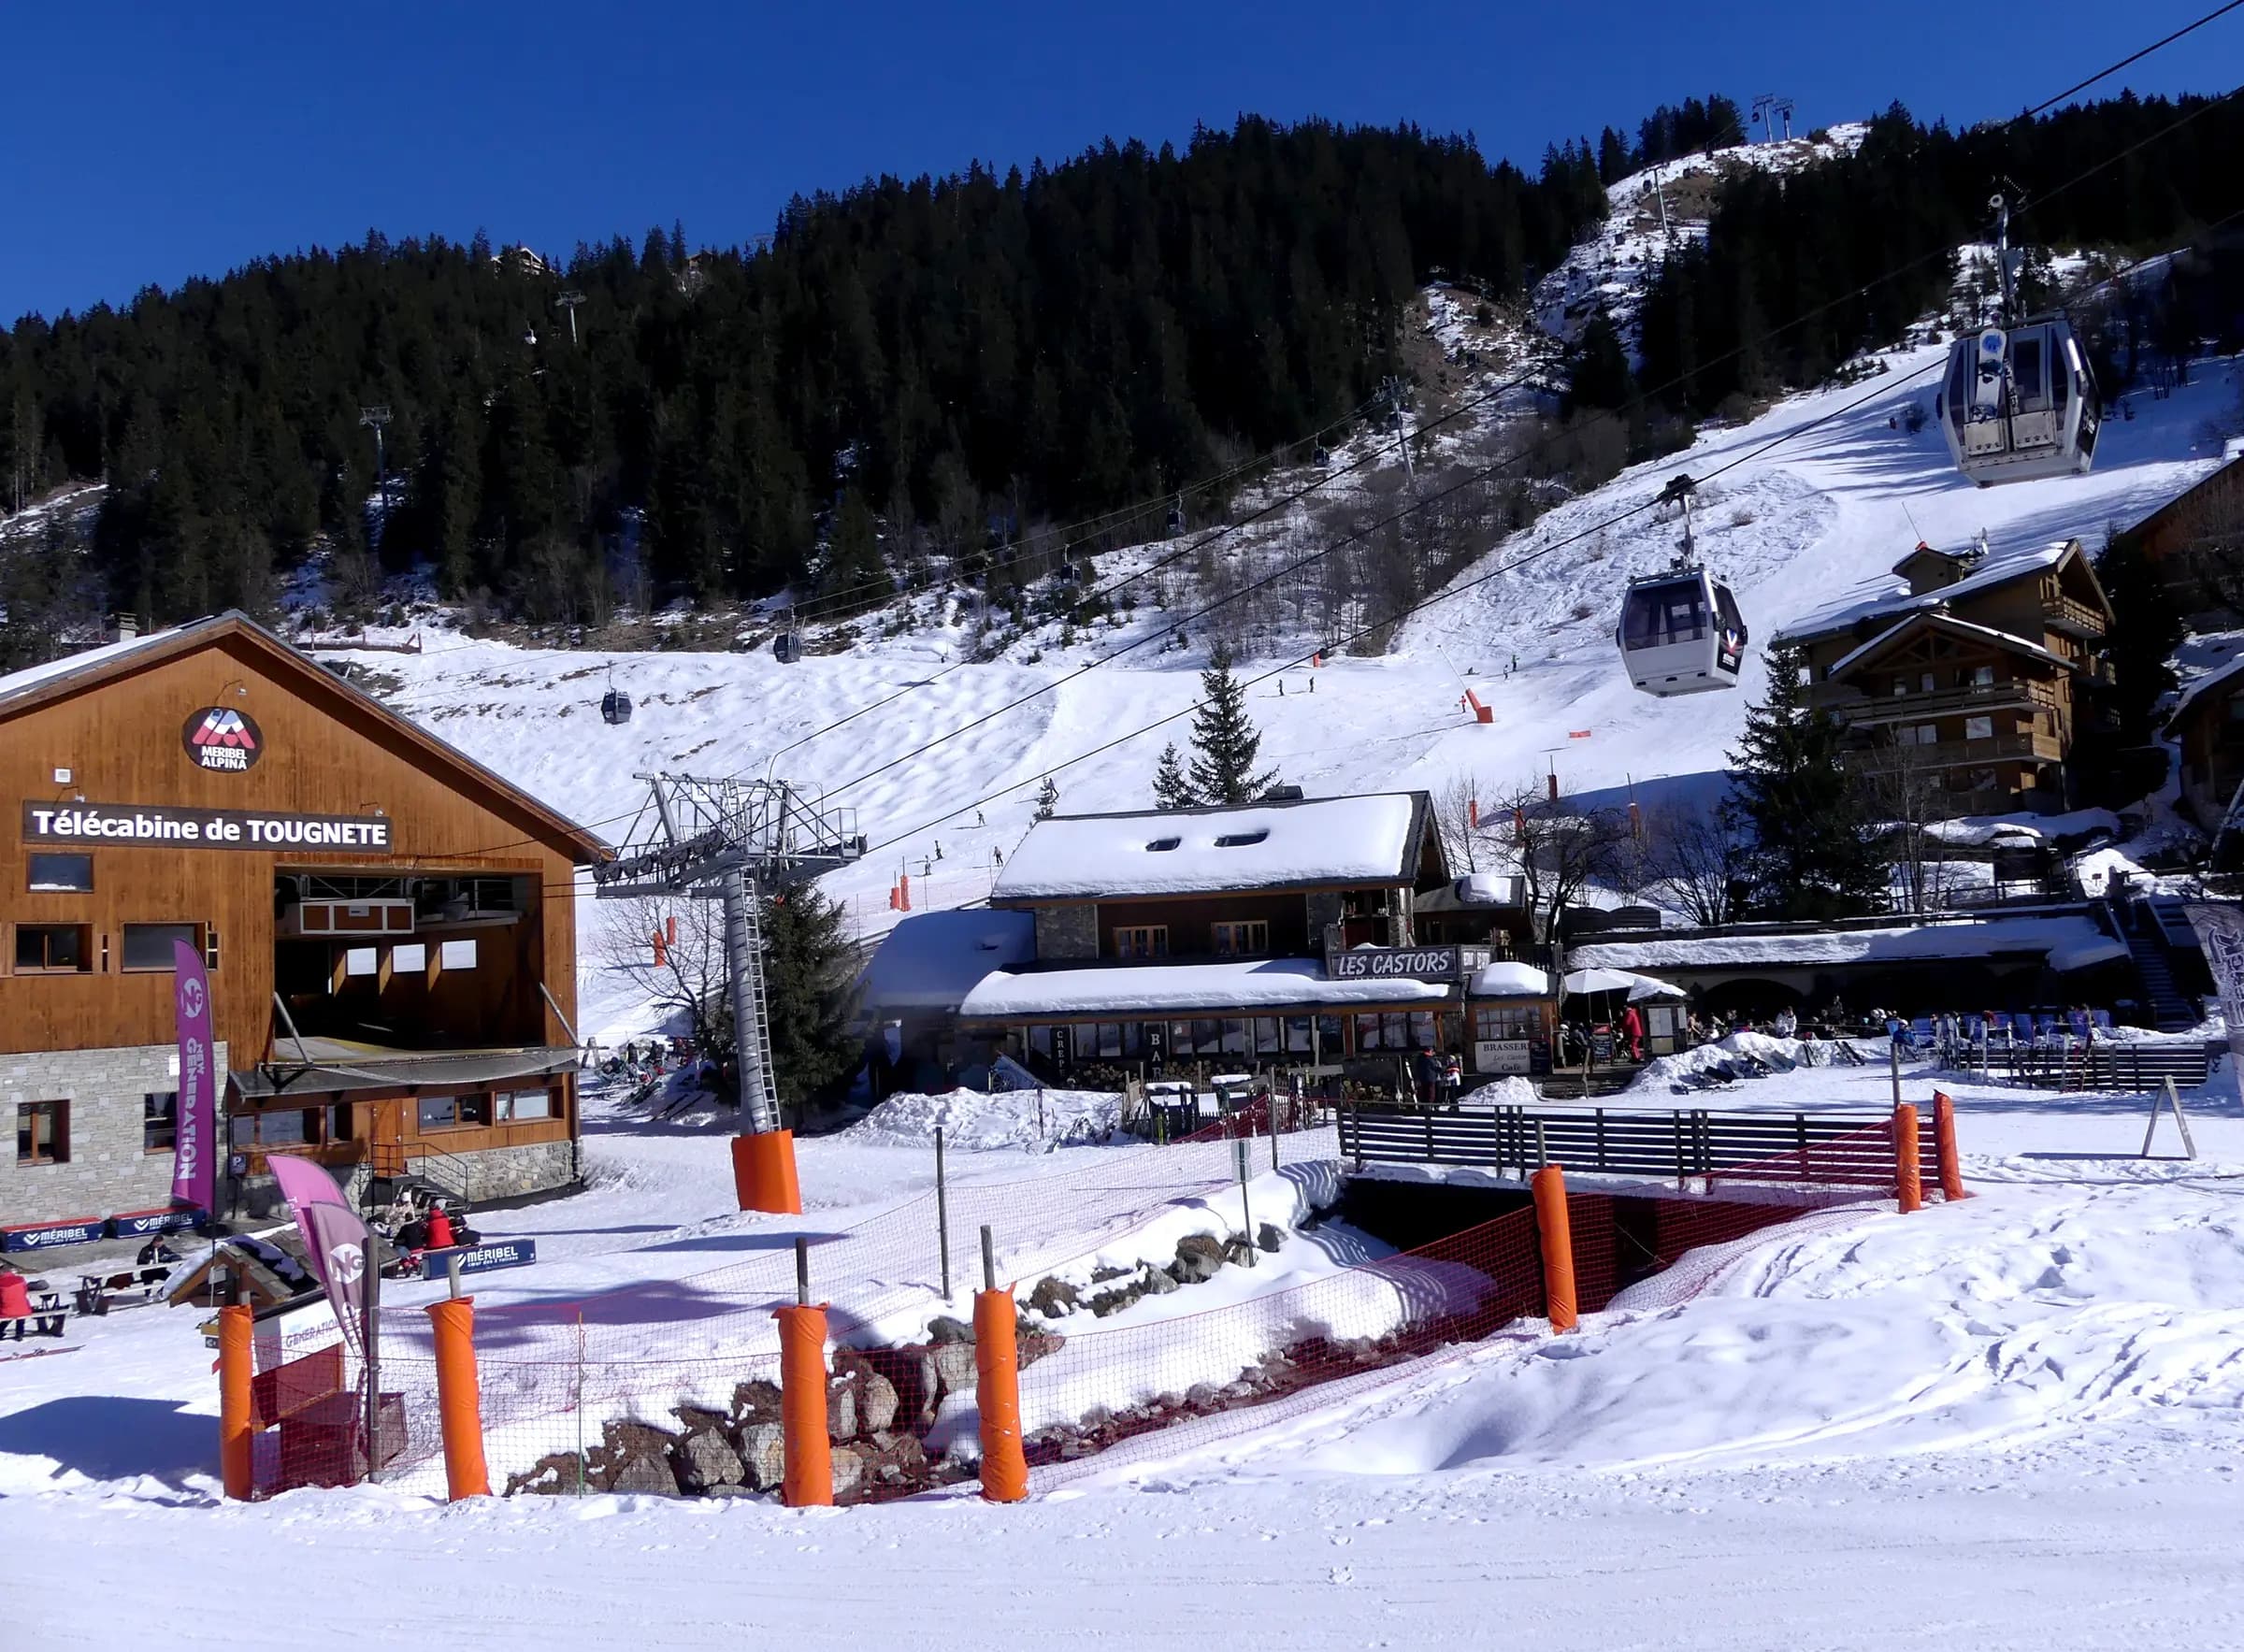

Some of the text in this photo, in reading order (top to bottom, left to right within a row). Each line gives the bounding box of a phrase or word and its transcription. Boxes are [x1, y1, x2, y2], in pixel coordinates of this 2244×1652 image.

[201, 745, 247, 760] MERIBEL
[201, 756, 247, 769] ALPINA
[32, 810, 387, 845] Télécabine de TOUGNETE
[1338, 951, 1449, 975] LES CASTORS
[195, 1041, 205, 1075] NEW
[178, 1036, 197, 1180] GENERATION
[233, 1156, 241, 1167] P
[150, 1214, 194, 1227] MÉRIBEL
[40, 1228, 88, 1242] MÉRIBEL
[468, 1246, 519, 1263] MÉRIBEL
